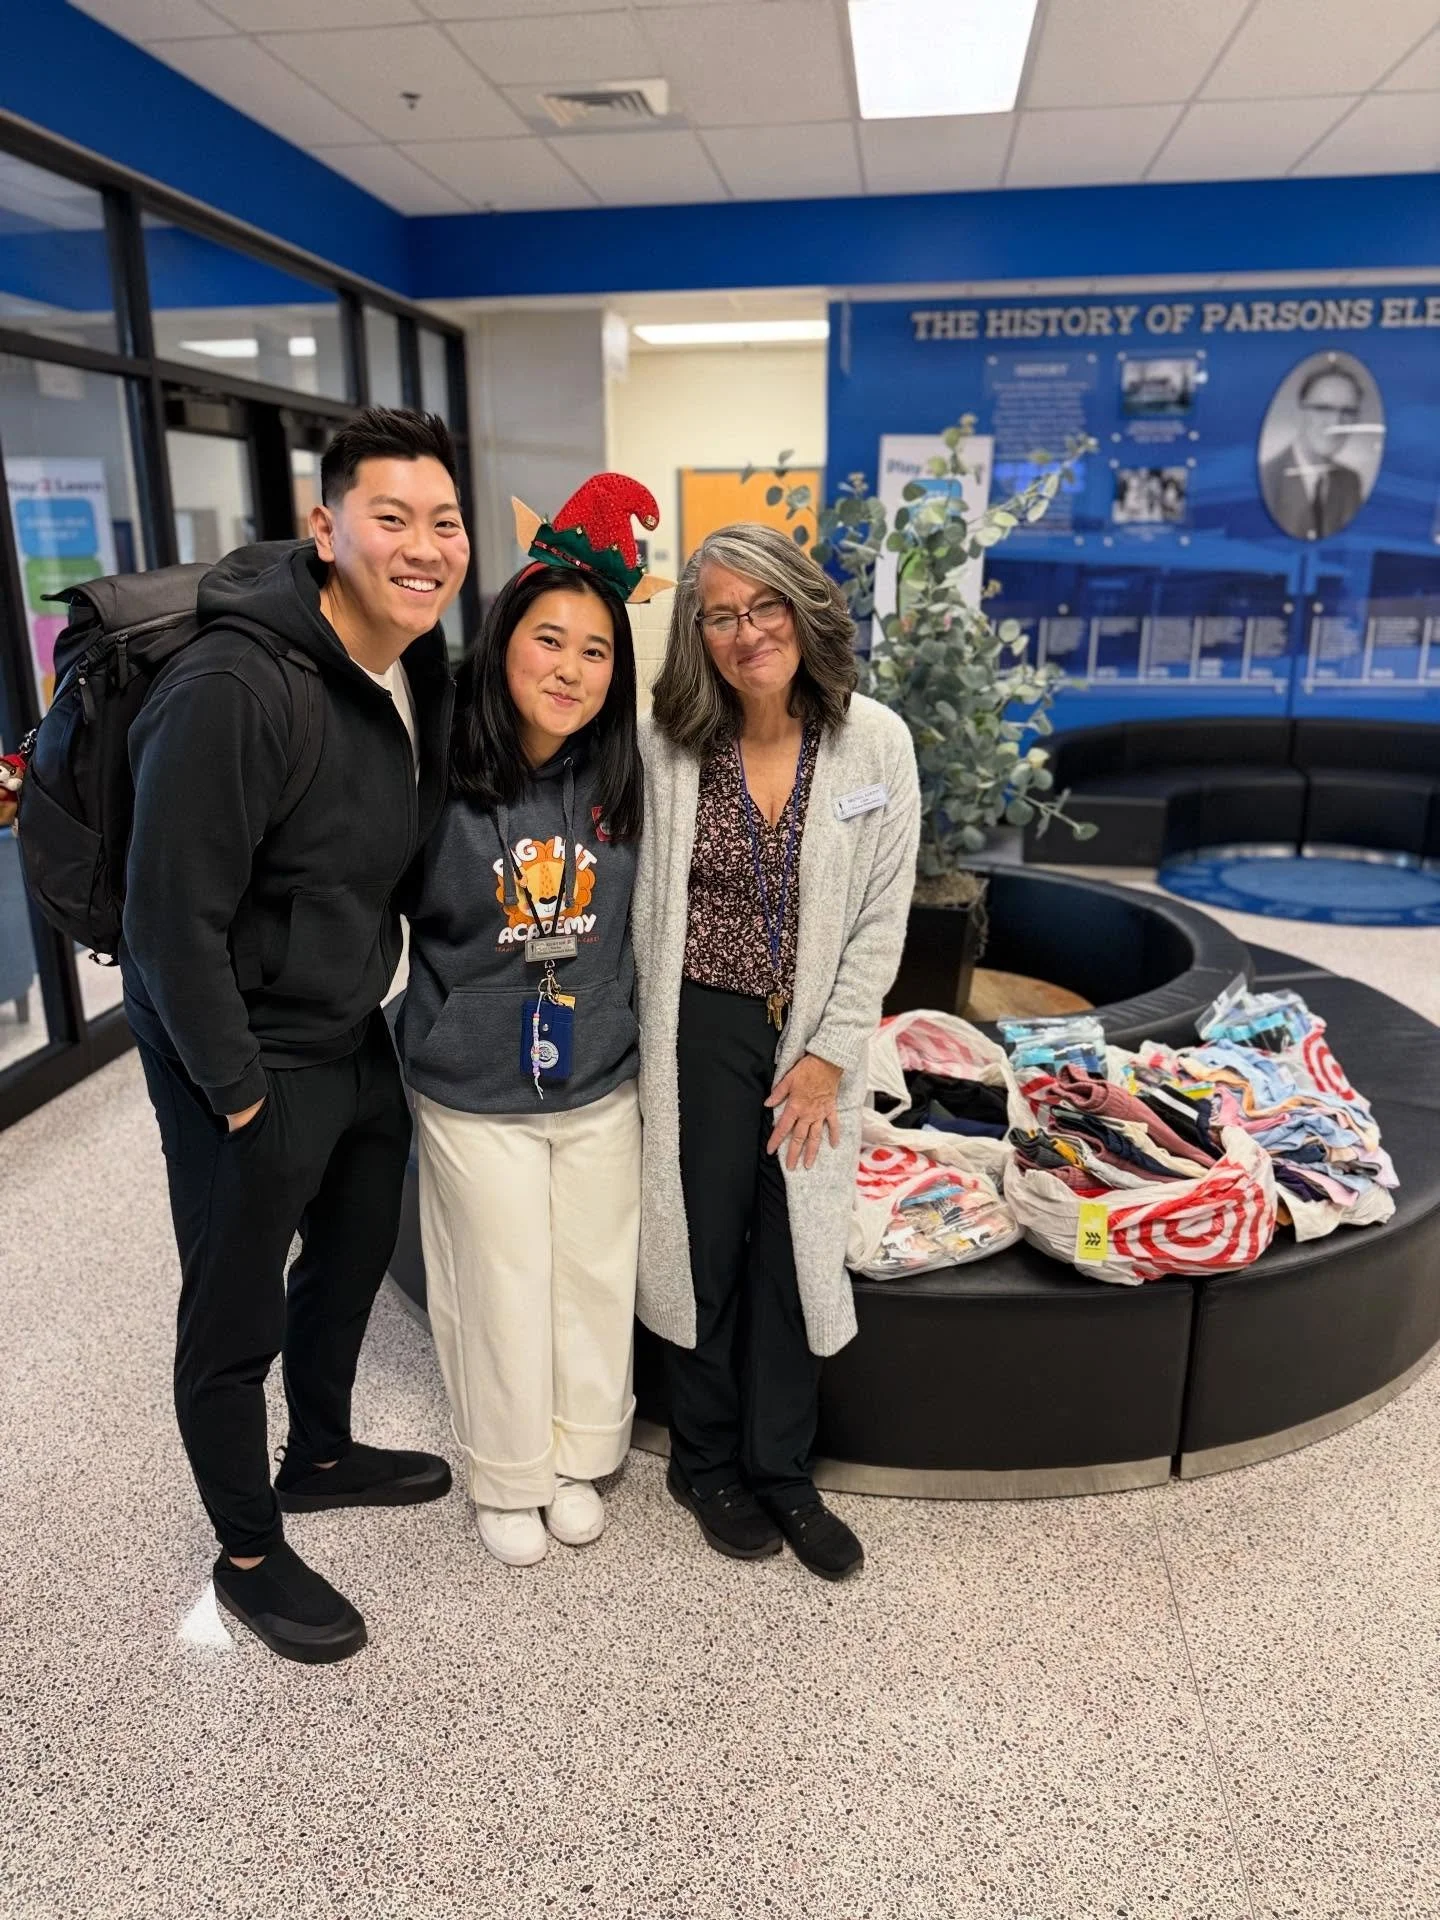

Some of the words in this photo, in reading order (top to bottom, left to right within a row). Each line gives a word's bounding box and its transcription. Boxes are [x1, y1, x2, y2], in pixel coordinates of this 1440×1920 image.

[911, 310, 980, 341] THE
[986, 305, 1138, 338] HISTORY
[1145, 303, 1193, 334] OF
[1202, 299, 1374, 333] PARSONS
[498, 913, 597, 944] ACADEMY
